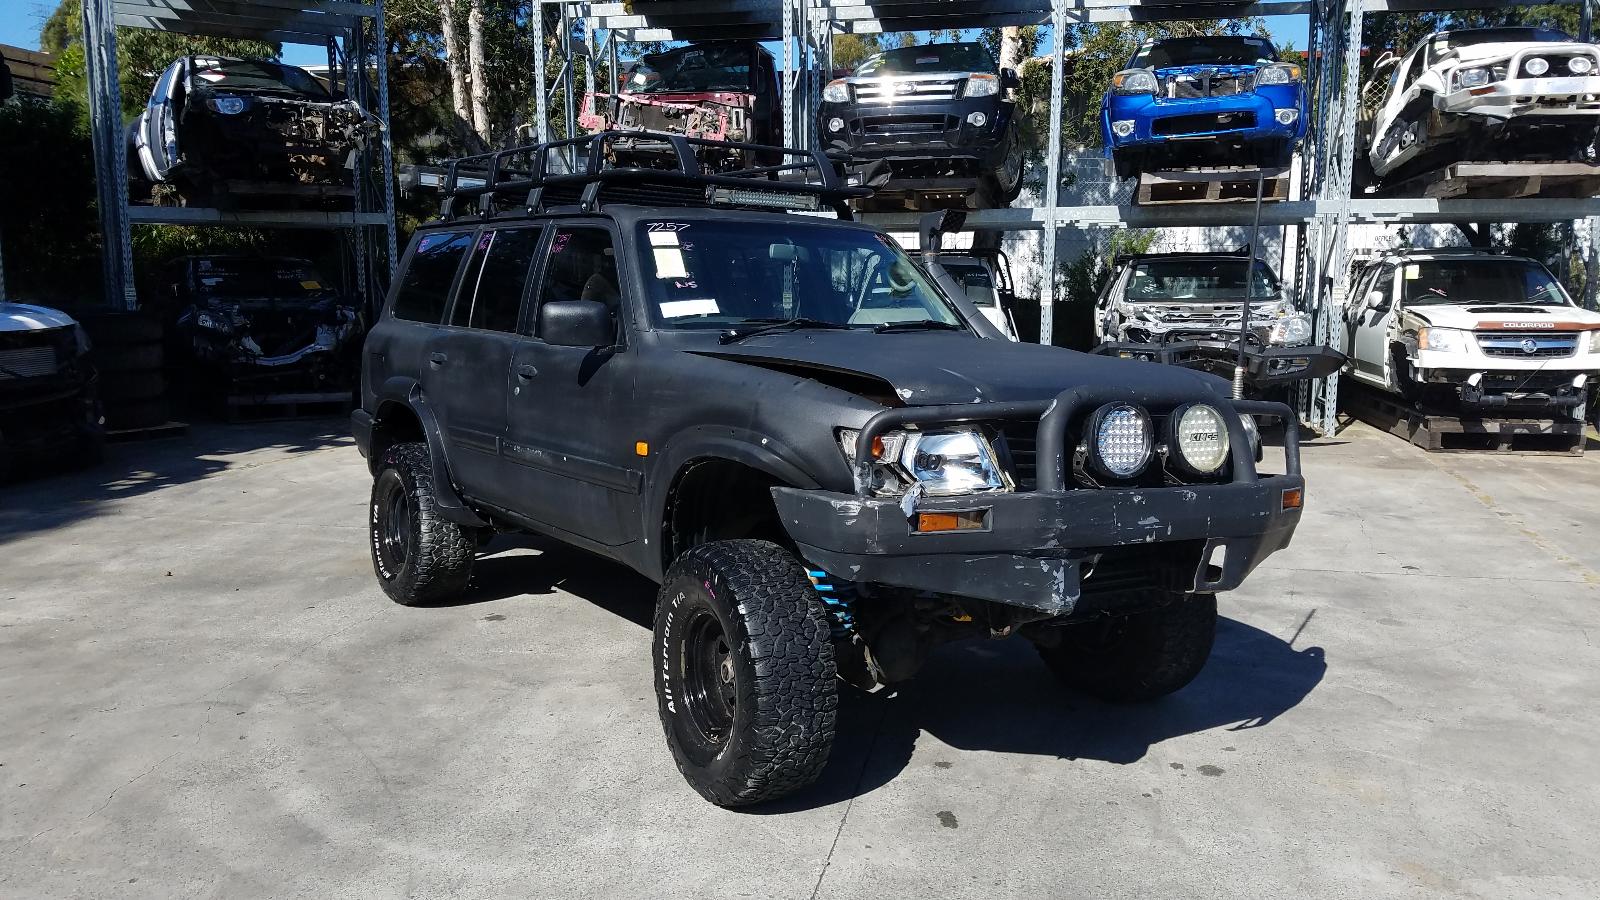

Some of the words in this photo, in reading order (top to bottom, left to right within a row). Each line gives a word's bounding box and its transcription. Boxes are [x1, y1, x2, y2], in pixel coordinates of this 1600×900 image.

[646, 222, 691, 233] 7257
[1190, 432, 1219, 441] KINGS
[662, 611, 677, 714] All-Terrain
[671, 591, 686, 609] T/A
